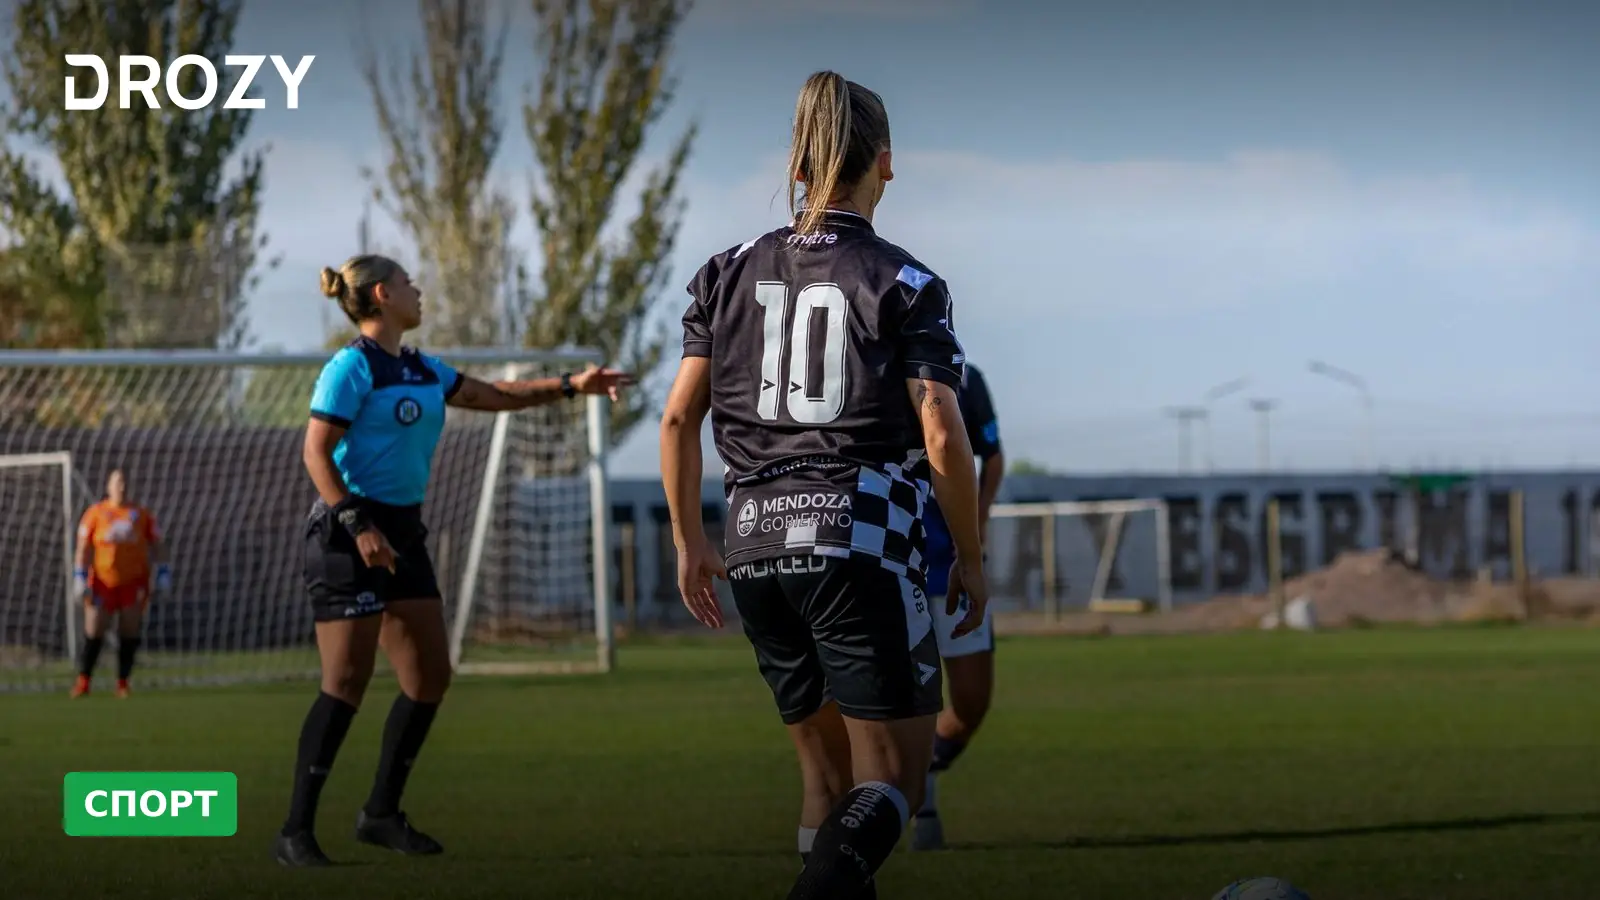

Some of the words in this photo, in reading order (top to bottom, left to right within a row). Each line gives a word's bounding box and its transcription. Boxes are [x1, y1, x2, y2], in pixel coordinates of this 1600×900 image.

[755, 281, 849, 424] 10
[762, 493, 852, 515] MENDOZA
[760, 512, 852, 534] GOBIERNO
[840, 788, 884, 829] mitre
